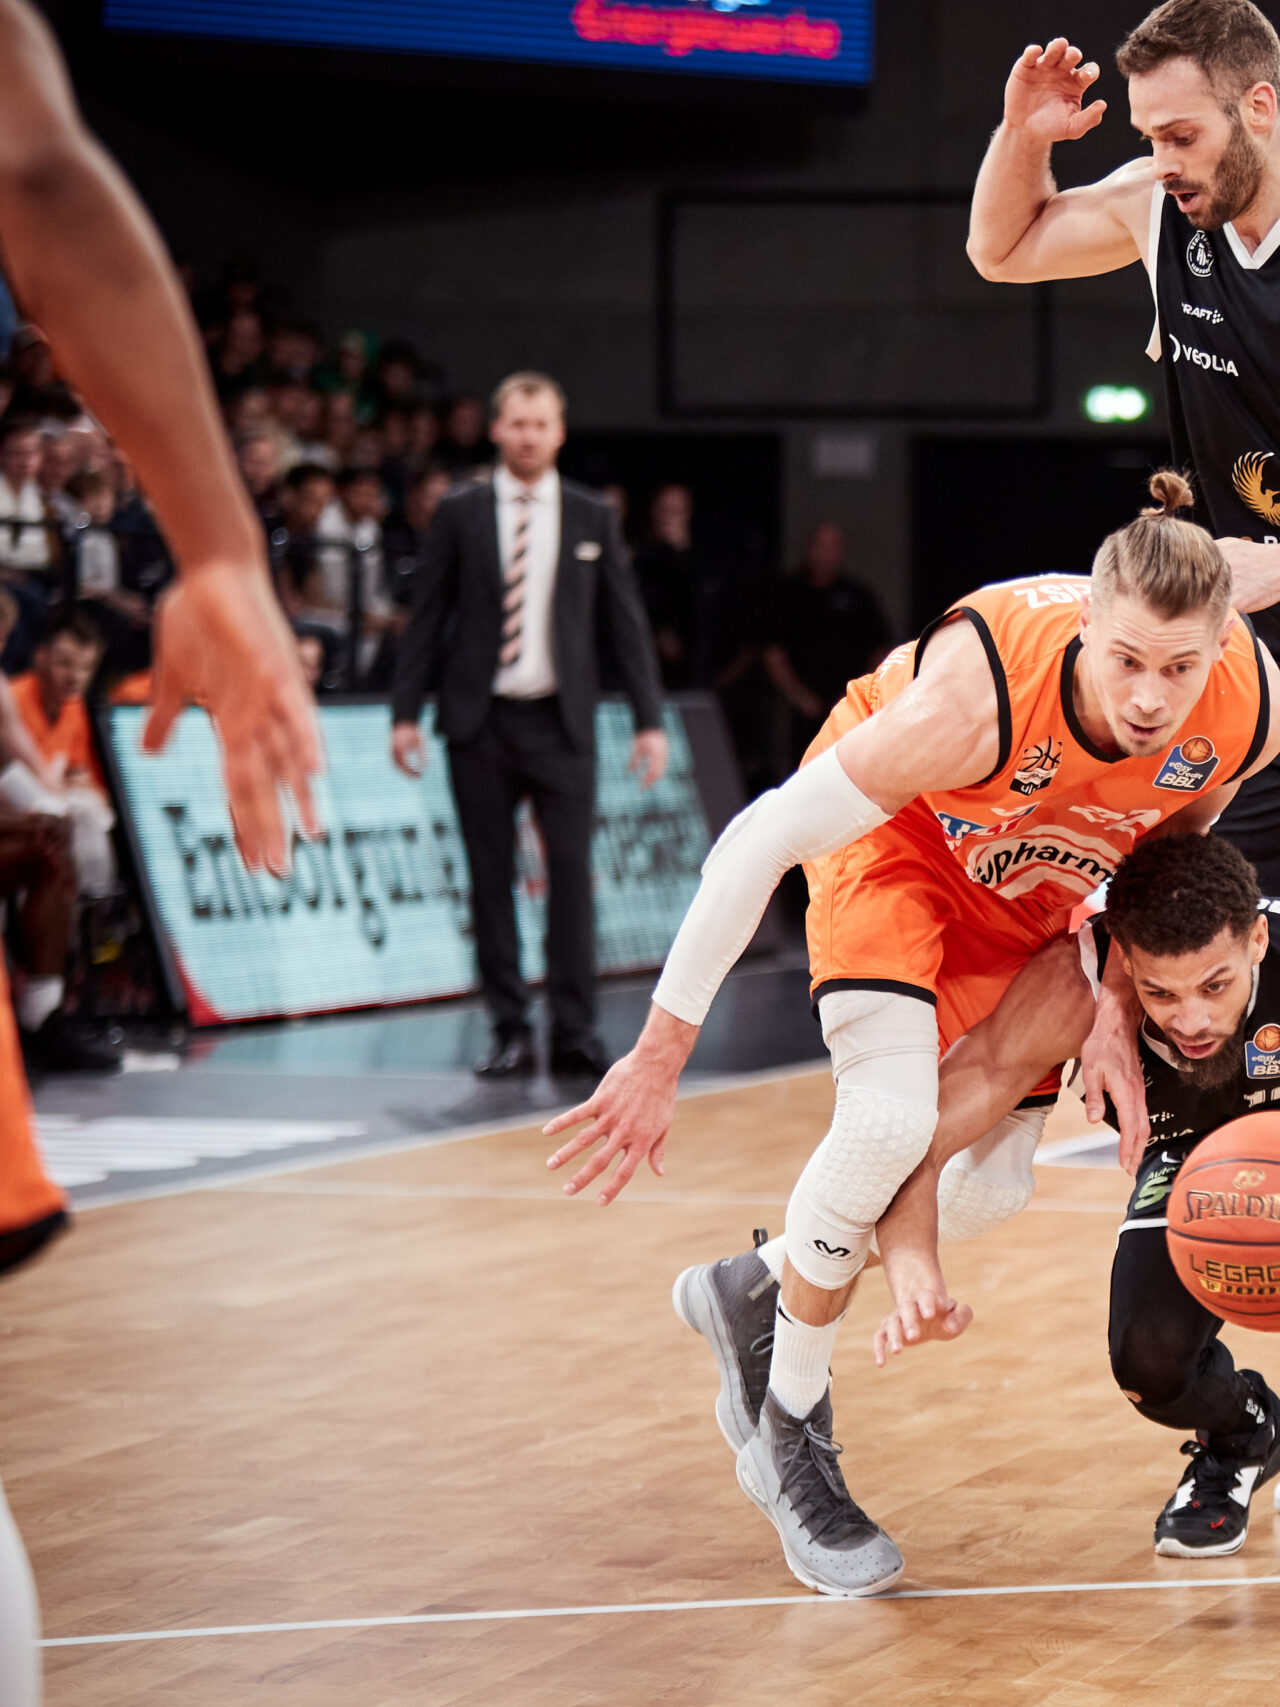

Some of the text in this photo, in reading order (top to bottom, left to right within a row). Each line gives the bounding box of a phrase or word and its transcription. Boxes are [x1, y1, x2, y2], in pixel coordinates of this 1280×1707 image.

[1182, 302, 1213, 320] RAFT
[1182, 344, 1239, 376] VEOLIA
[1159, 772, 1196, 788] BBL
[977, 842, 1112, 884] pharm
